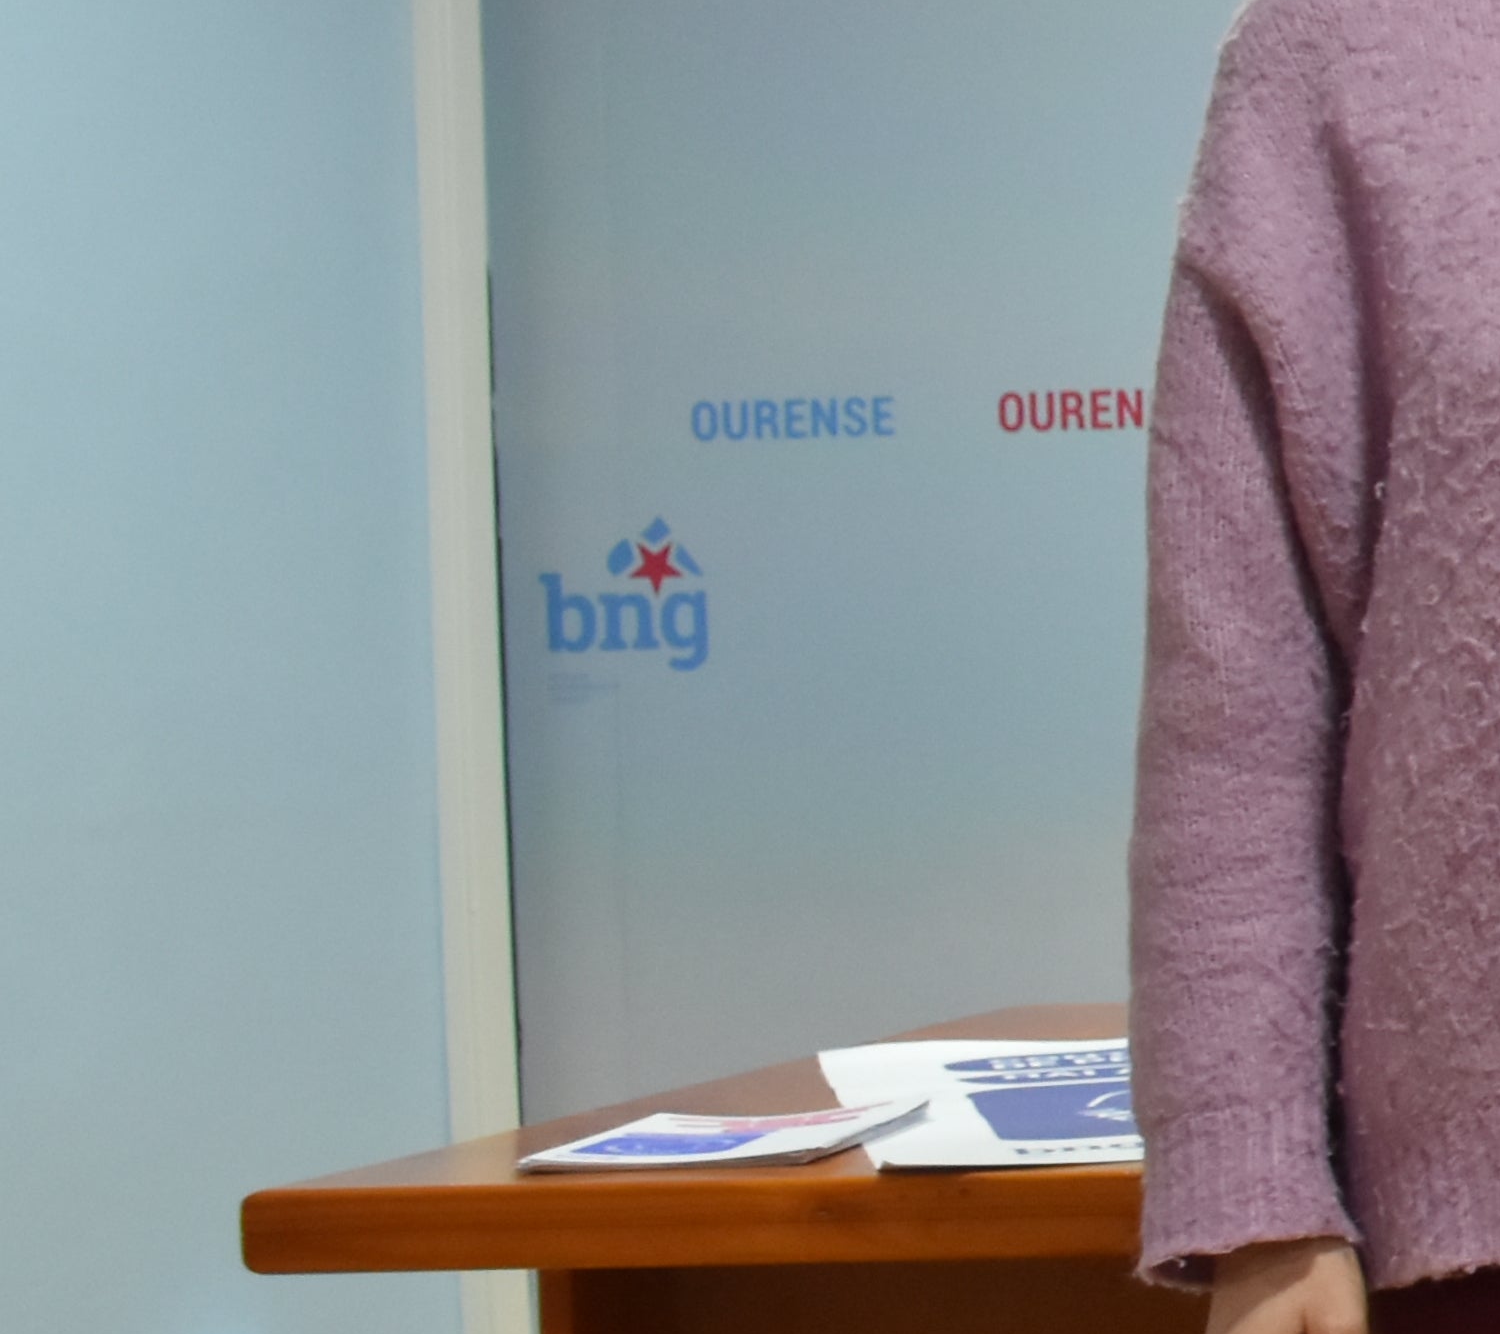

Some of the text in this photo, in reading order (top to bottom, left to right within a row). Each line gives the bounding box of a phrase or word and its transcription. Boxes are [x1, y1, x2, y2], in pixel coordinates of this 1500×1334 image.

[691, 396, 896, 443] OURENSE
[998, 389, 1145, 433] OUREN
[539, 571, 711, 673] bng
